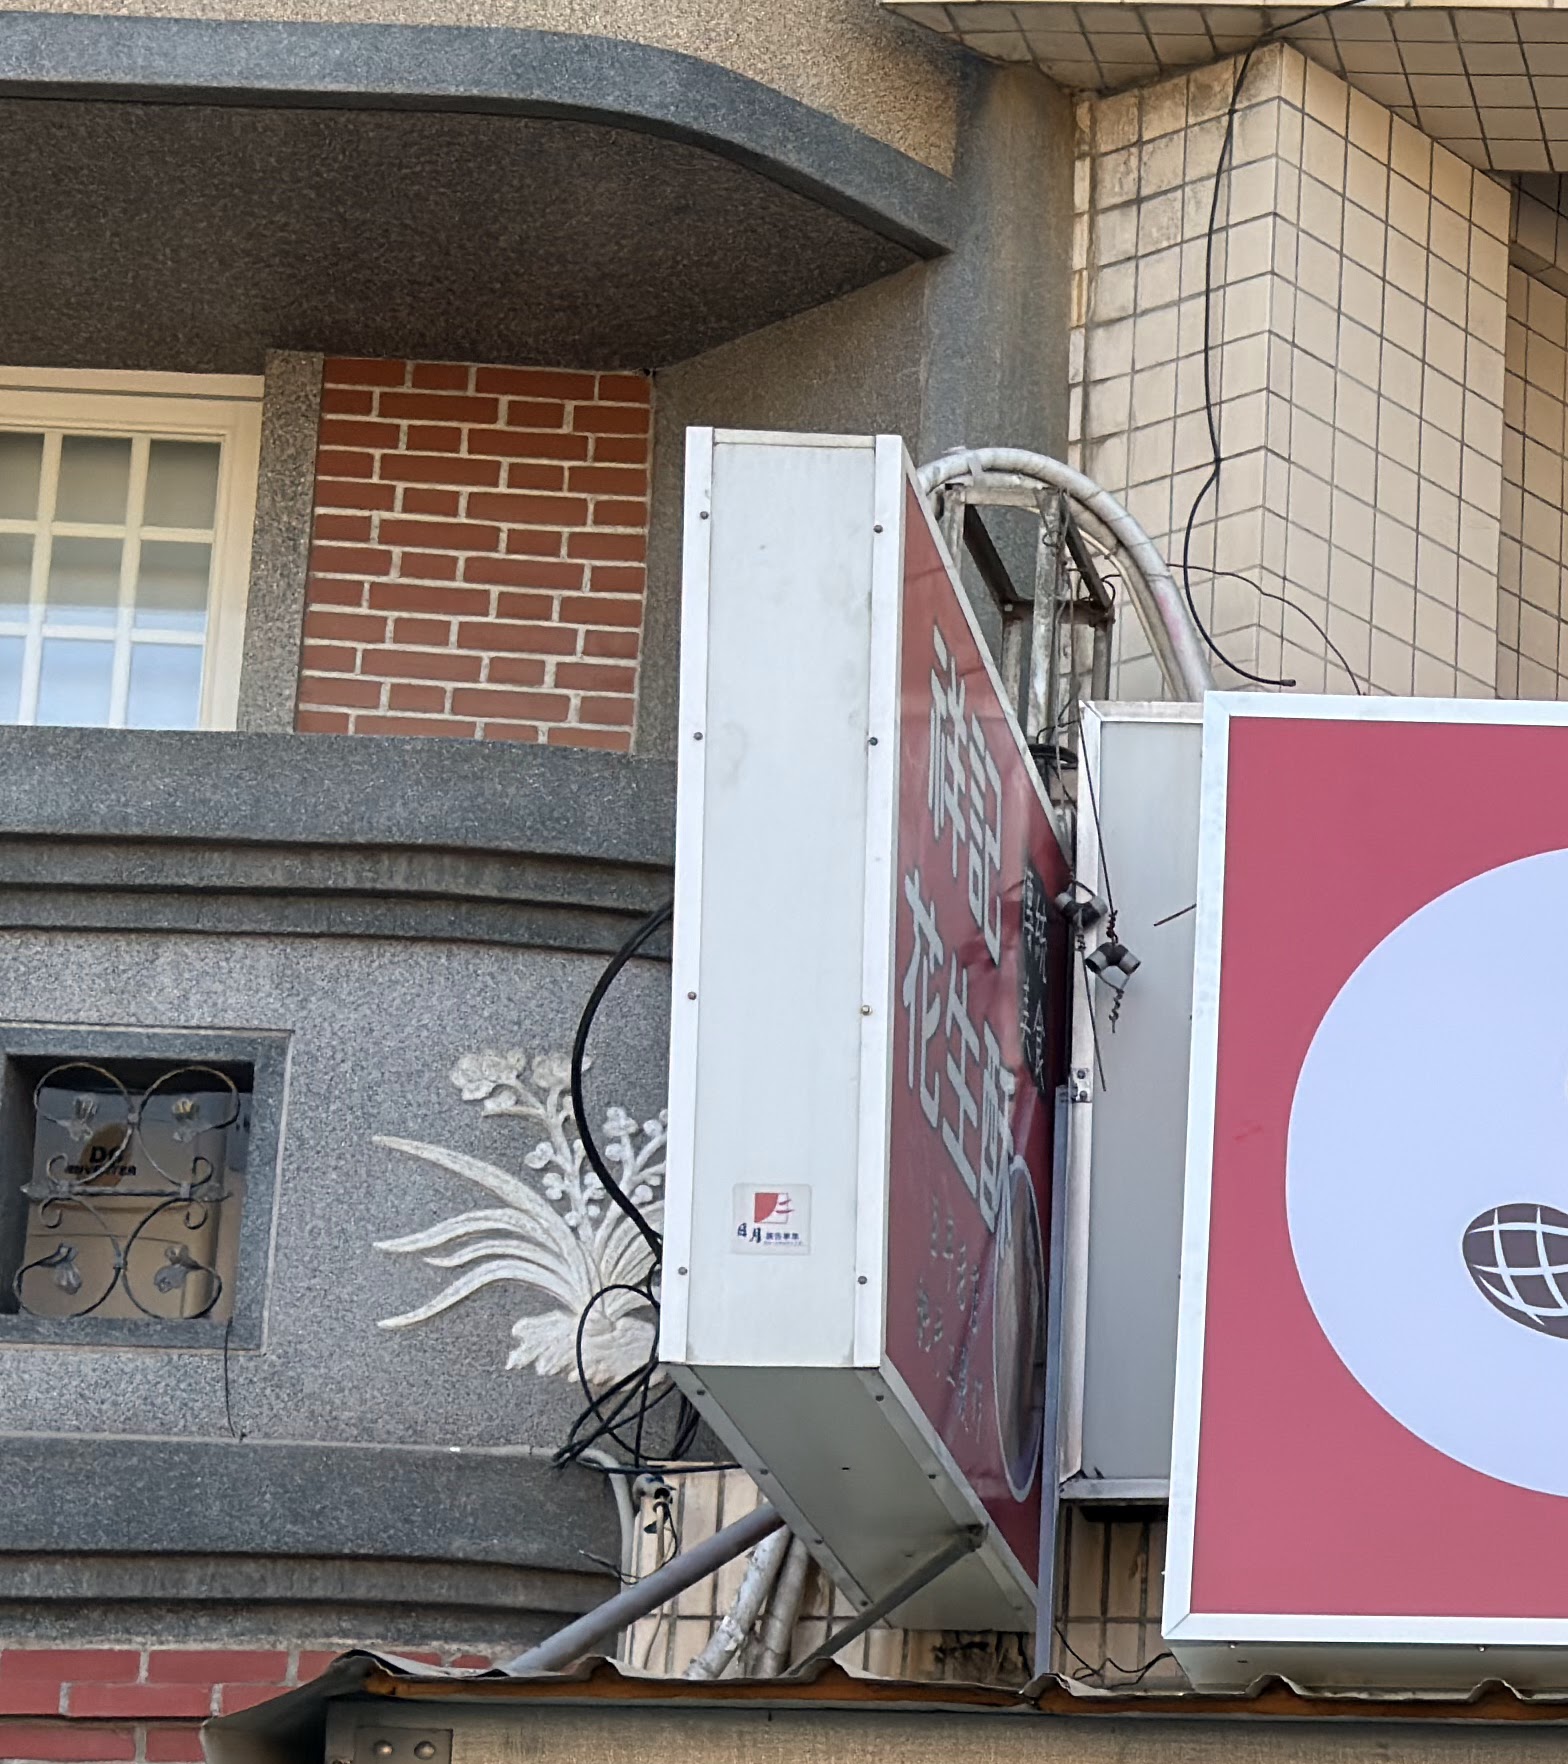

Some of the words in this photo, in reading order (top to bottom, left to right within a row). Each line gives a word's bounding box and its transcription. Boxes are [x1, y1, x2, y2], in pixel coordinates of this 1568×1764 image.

[928, 625, 1002, 966] 祥記
[903, 864, 1016, 1257] 花生酥
